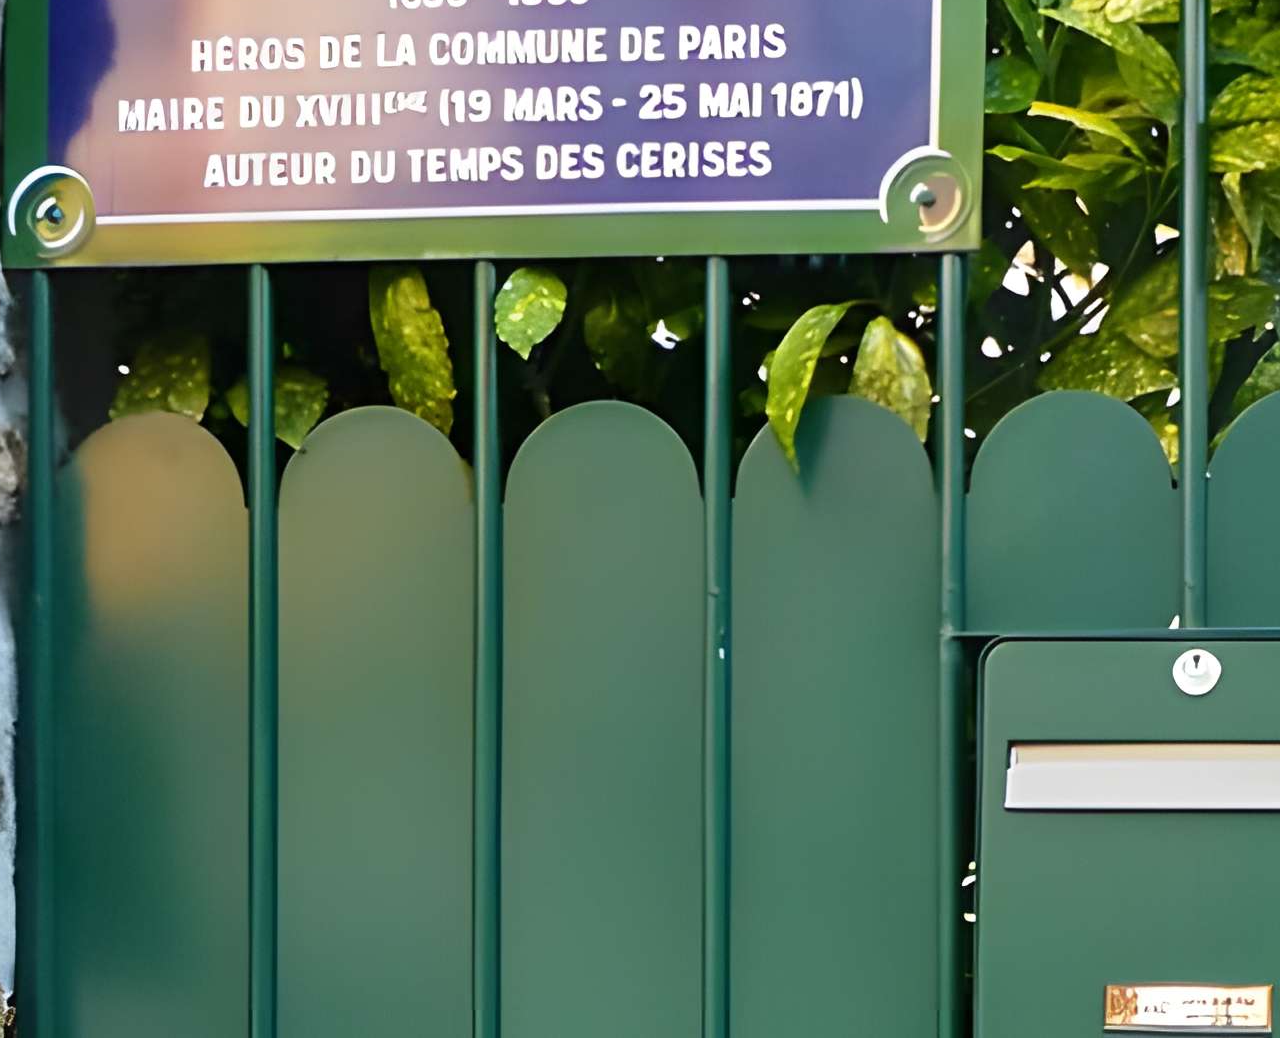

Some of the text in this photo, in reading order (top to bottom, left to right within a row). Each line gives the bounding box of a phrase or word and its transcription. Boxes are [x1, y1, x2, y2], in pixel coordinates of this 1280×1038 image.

[319, 34, 363, 69] DE
[376, 33, 417, 68] LA
[428, 27, 608, 66] COMMUNE
[620, 26, 665, 62] DE
[678, 23, 787, 60] PARIS
[118, 96, 225, 132] MAIRE
[239, 95, 285, 129] DU
[439, 88, 492, 127] (19
[503, 85, 603, 122] MARS
[638, 83, 687, 120] 25
[699, 82, 762, 118] MAI
[770, 77, 863, 119] 1871)
[203, 140, 772, 188] AUTEUR DU TEMPS DES CERISES
